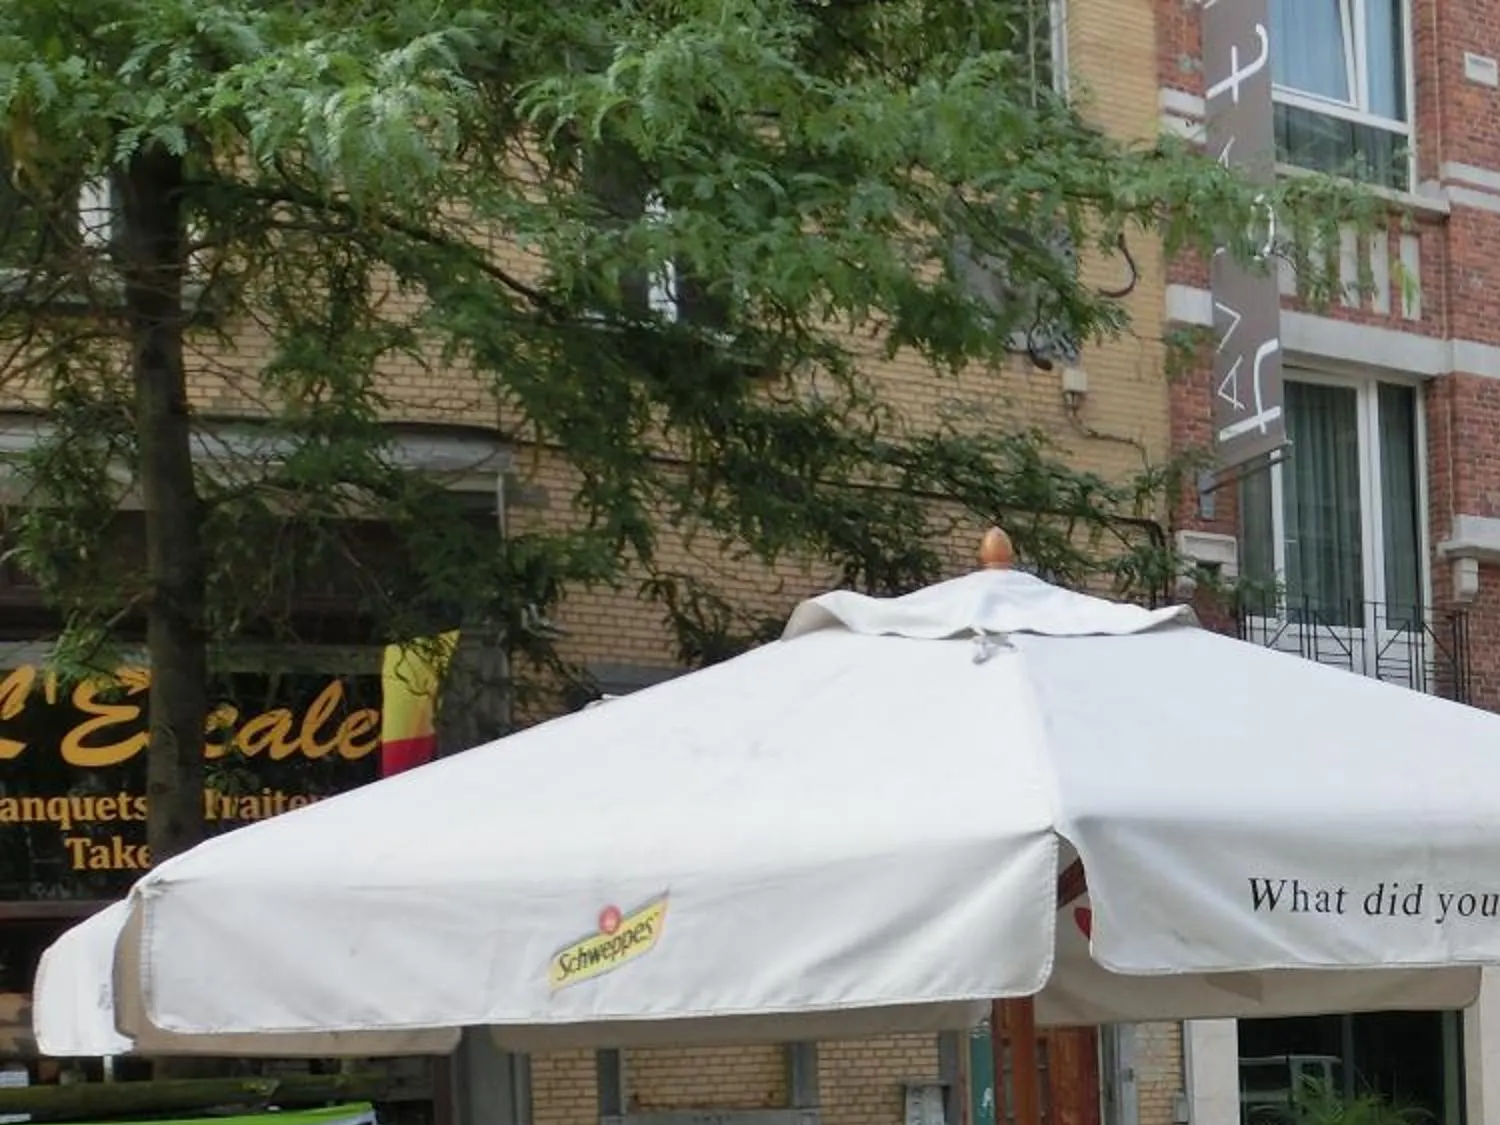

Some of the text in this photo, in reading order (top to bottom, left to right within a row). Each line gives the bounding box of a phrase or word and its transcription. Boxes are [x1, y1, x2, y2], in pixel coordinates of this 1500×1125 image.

[1248, 877, 1348, 914] What
[1363, 883, 1424, 917] did
[1435, 891, 1500, 924] you
[556, 916, 655, 981] Schweppes
